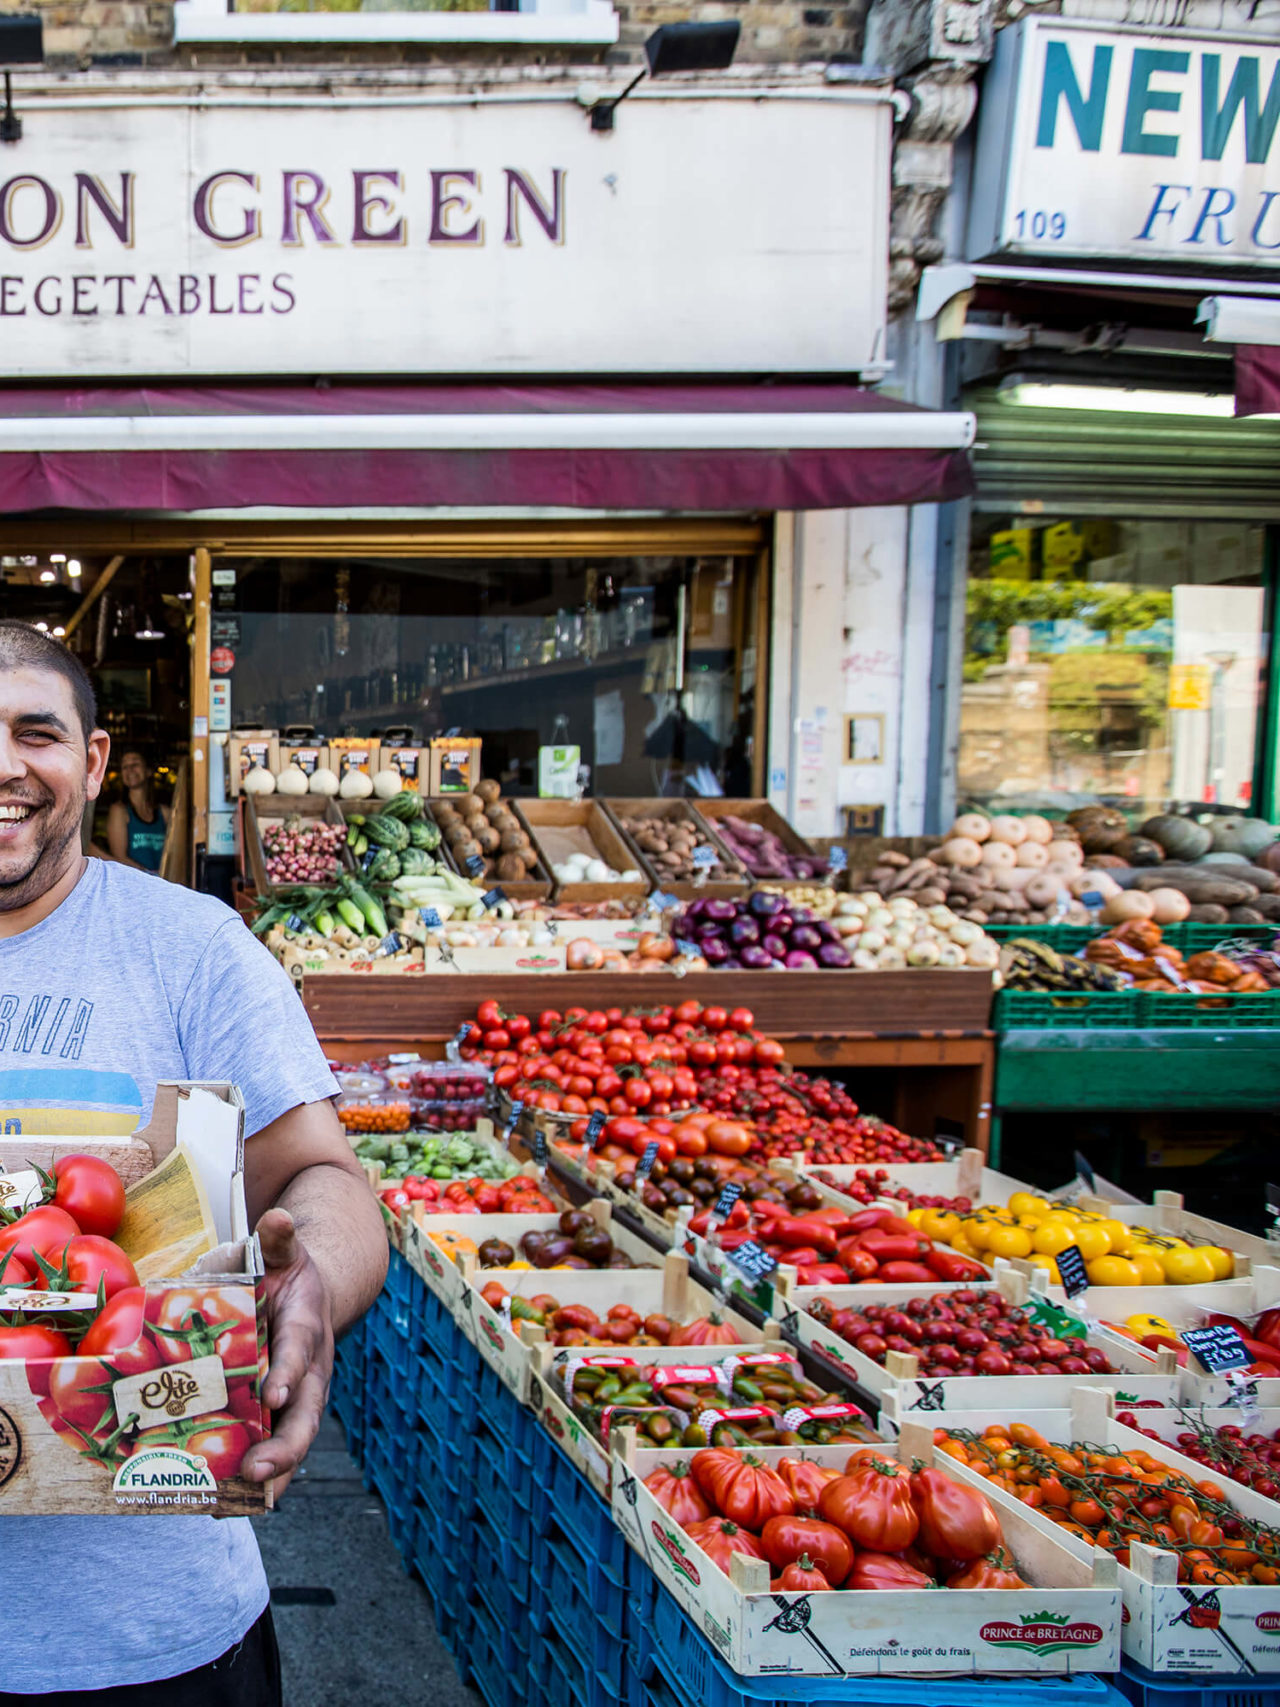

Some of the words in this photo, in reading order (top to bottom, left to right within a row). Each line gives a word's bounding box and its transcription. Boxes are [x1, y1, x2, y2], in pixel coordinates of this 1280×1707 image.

[1035, 41, 1280, 164] NEW
[194, 168, 567, 248] GREEN
[1015, 209, 1067, 240] 109
[131, 1473, 210, 1486] FLANDRIA
[115, 1491, 218, 1505] www.flandria.be
[982, 1627, 1023, 1639] PRINCE
[1025, 1628, 1036, 1639] de
[1037, 1628, 1099, 1641] BRETAGNE
[850, 1648, 897, 1657] Défendons
[900, 1648, 909, 1657] le
[911, 1647, 933, 1659] goût
[935, 1648, 947, 1657] du
[949, 1647, 971, 1657] frais
